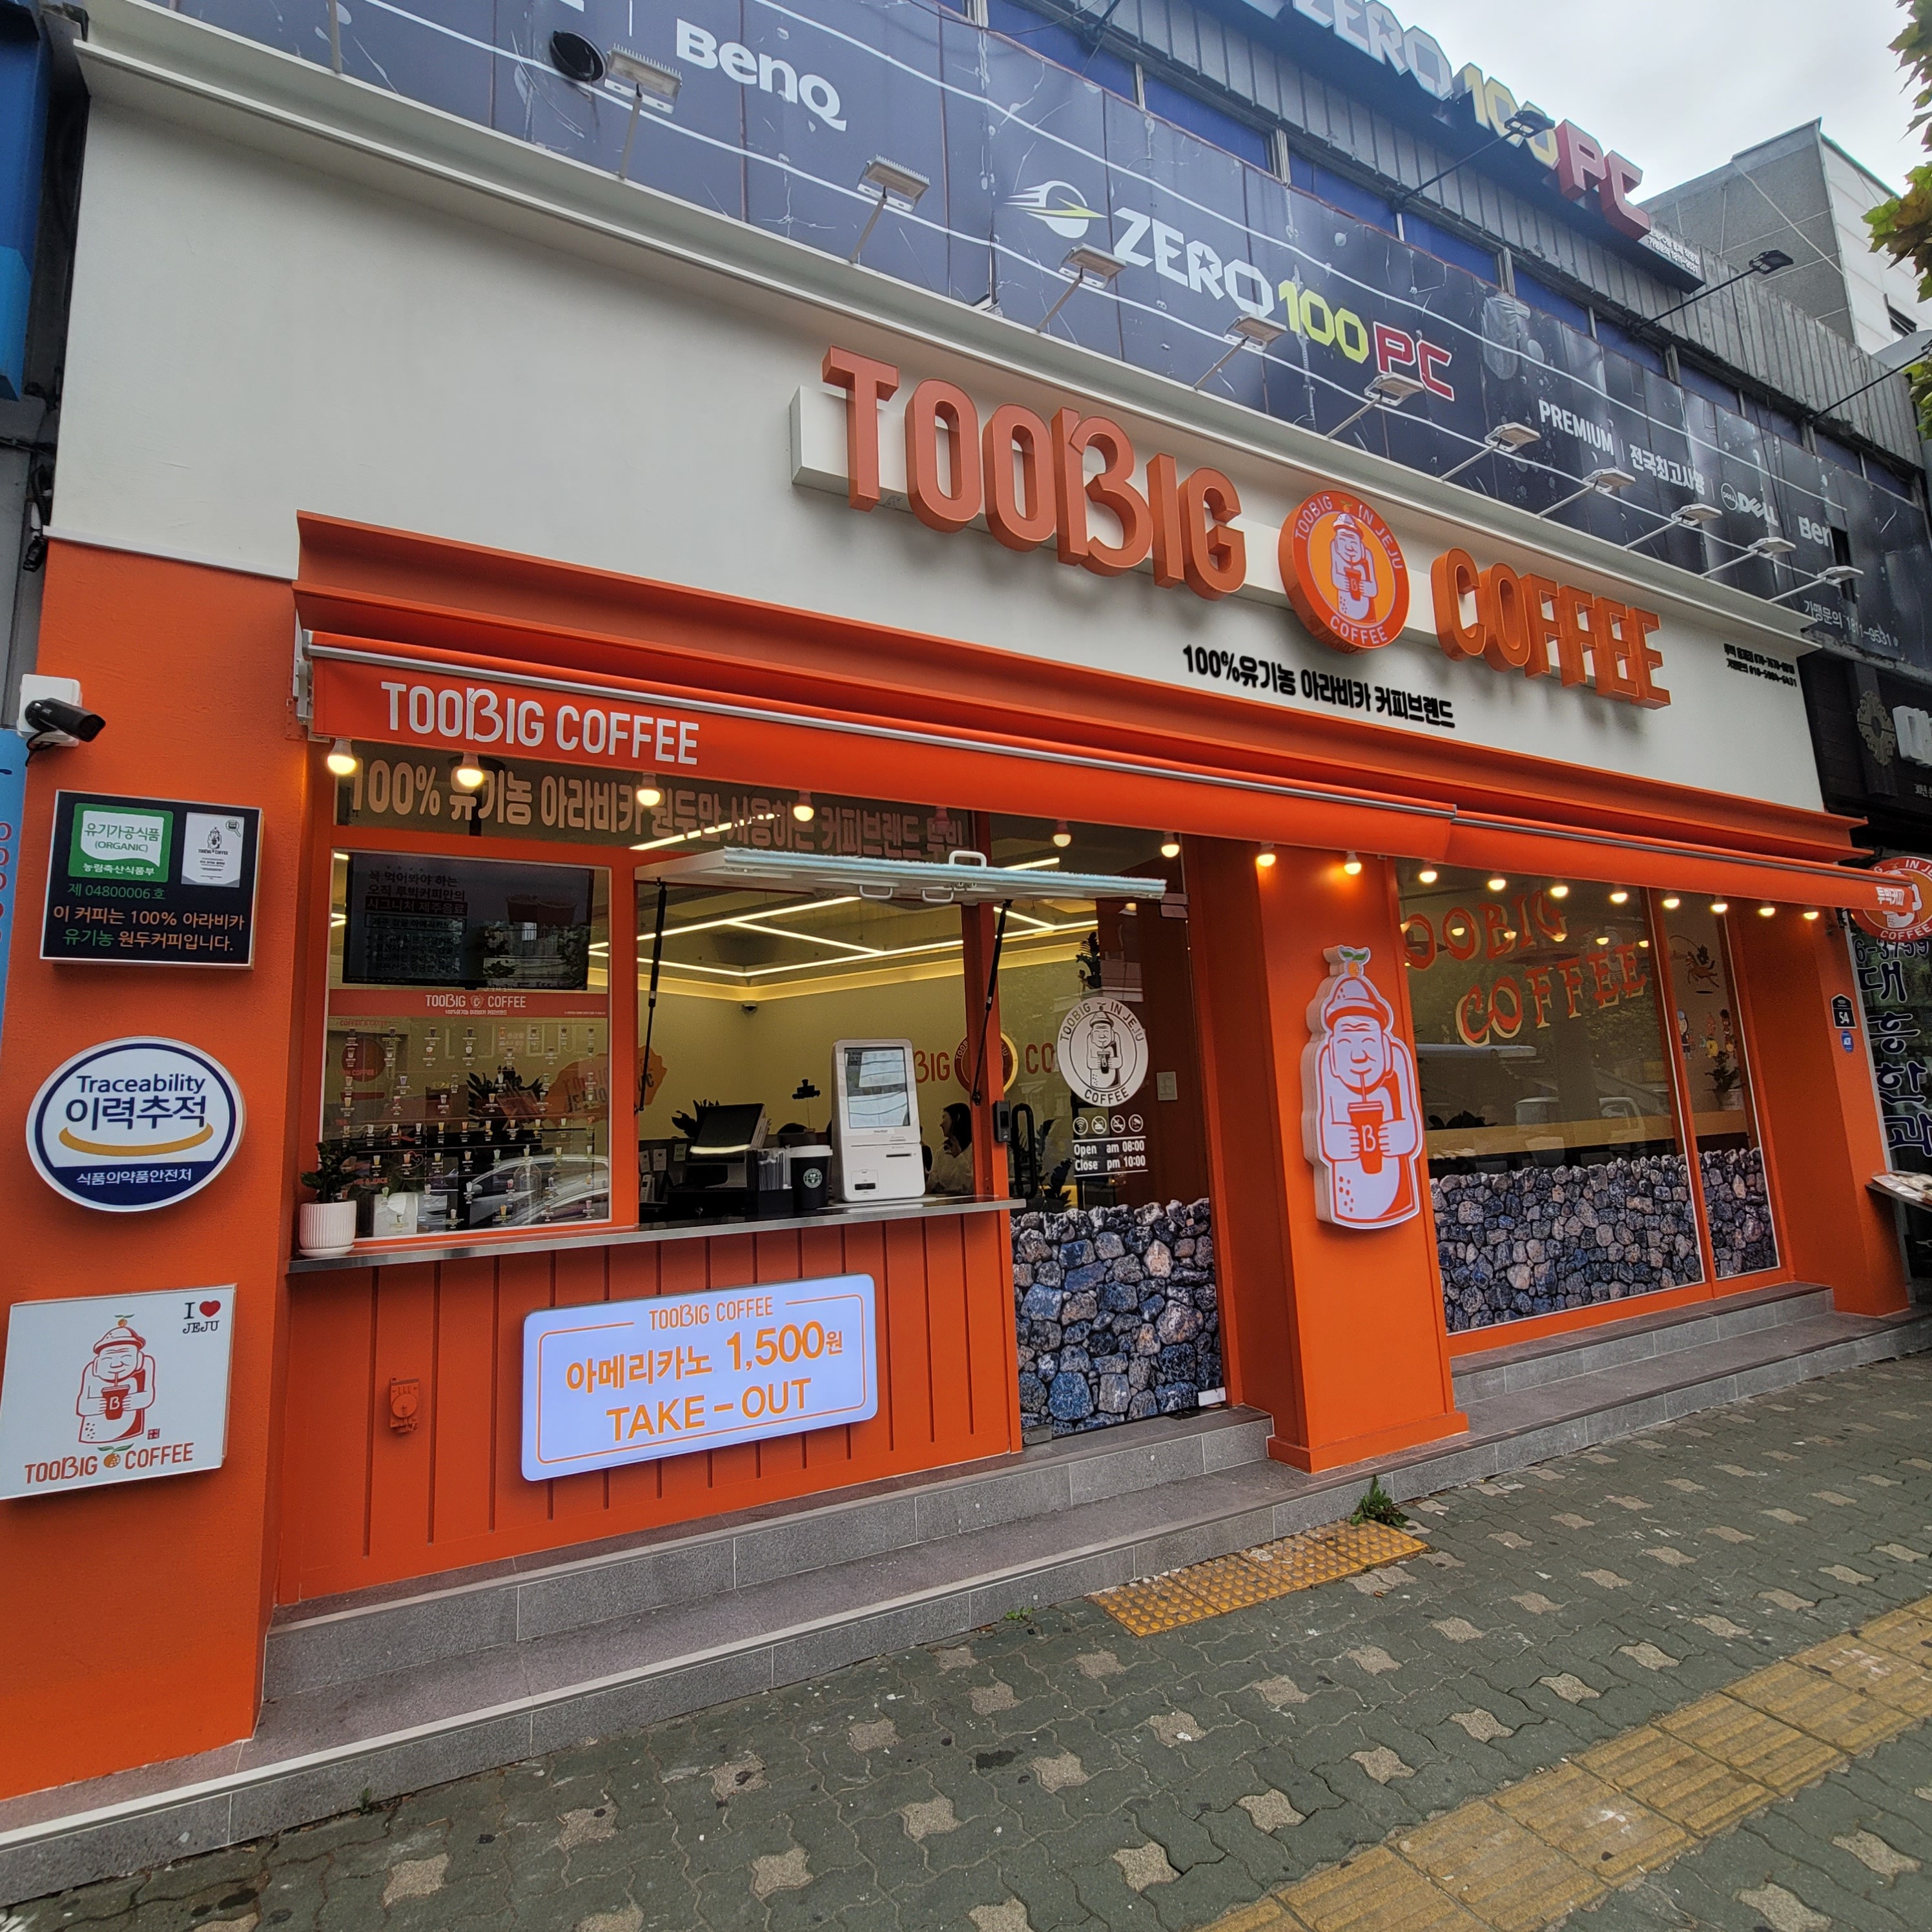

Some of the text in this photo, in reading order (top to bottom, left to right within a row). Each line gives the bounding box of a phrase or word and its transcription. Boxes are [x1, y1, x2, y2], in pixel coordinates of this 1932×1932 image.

[677, 18, 847, 132] BenQ
[1538, 399, 1614, 456] PREMIUM
[1629, 444, 1705, 496] 전국최고사양
[821, 345, 1671, 710] TOOBIG COFFEE
[1295, 495, 1403, 570] TOOBIG IN JEJU
[1798, 515, 1833, 548] Ben
[1330, 615, 1388, 644] COFFEE
[1804, 600, 1843, 630] 가맹문의
[1183, 644, 1456, 729] 100%유기농 아라비카 커피브랜드
[381, 681, 700, 766] TOOBIG COFFEE
[352, 756, 441, 817] 100%
[540, 775, 643, 835] 아라비카
[821, 806, 922, 859] 커피브랜드
[84, 823, 160, 841] 유기가공식품
[95, 841, 149, 853] (ORGANIC)
[83, 863, 155, 876] 농림축산식품부
[67, 883, 82, 897] 제
[54, 906, 245, 931] 이 커피는 100% 아라비카
[1403, 890, 1568, 970] OOBIG
[63, 928, 234, 952] 유기농 원두커피입니다.
[426, 994, 526, 1008] TOOBIG COFFEE
[1455, 943, 1648, 1047] COFFEE
[1060, 1003, 1091, 1041] TOOBIG
[1110, 1002, 1122, 1015] IN
[76, 1073, 206, 1094] Traceability
[1084, 1087, 1129, 1104] COFFEE
[66, 1095, 207, 1131] 이력추적
[1074, 1140, 1145, 1157] Open am 08:00
[1074, 1155, 1146, 1171] Close pm 10:00
[76, 1168, 192, 1186] 식품의약품안전처
[182, 1321, 220, 1333] JEJU
[649, 1297, 773, 1331] TOOBIG COFFEE
[566, 1321, 843, 1393] 아메리카노 1,500원
[25, 1443, 194, 1484] TOOBIG COFFEE
